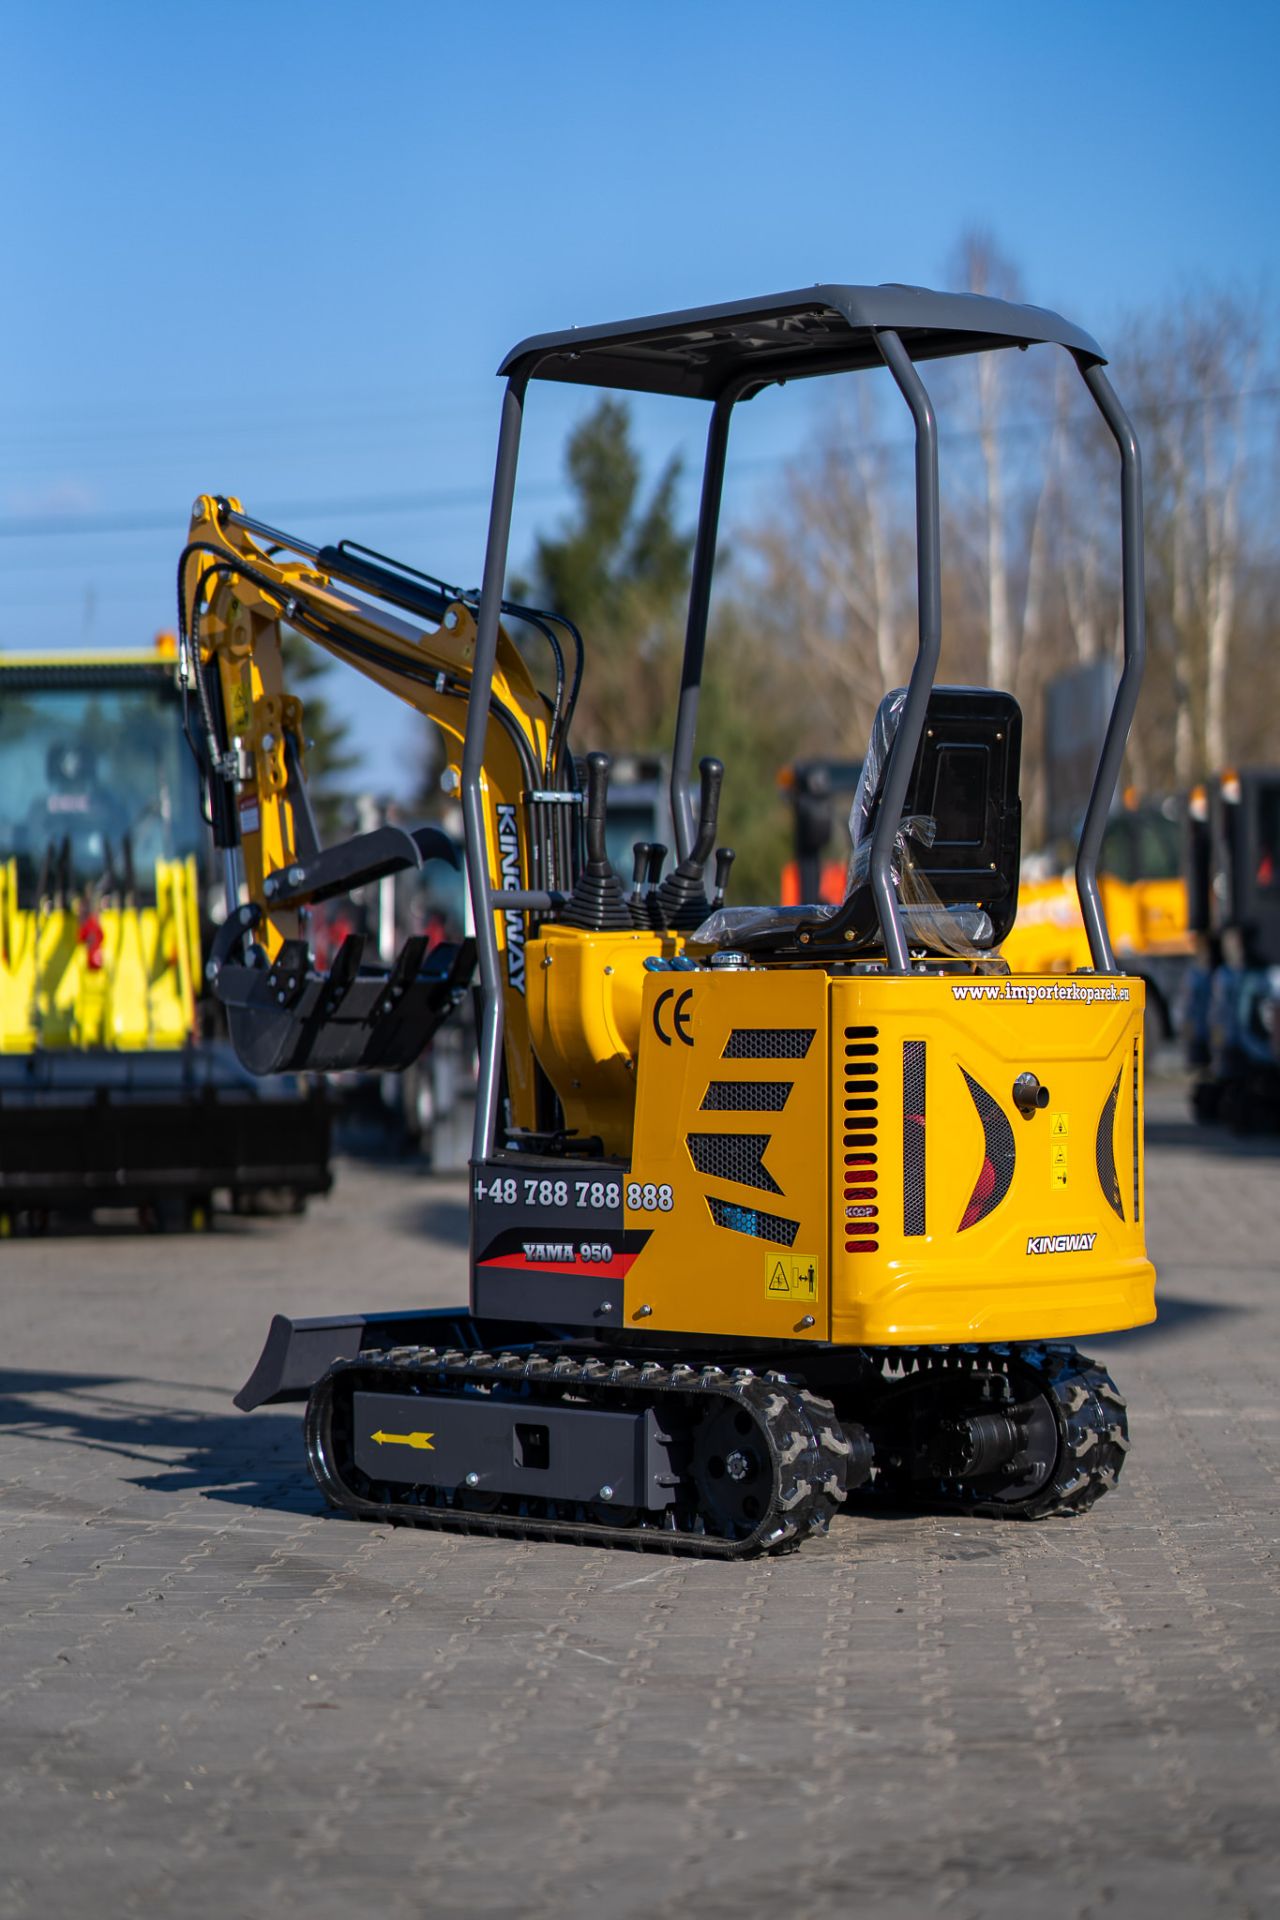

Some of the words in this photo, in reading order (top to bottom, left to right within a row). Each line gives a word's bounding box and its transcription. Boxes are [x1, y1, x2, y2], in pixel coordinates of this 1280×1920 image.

[952, 981, 1130, 1005] www.importerkoparek.eu
[653, 988, 694, 1046] CE
[475, 1178, 517, 1204] +48
[524, 1179, 568, 1206] 788
[575, 1182, 620, 1208] 788
[626, 1184, 674, 1211] 888
[523, 1242, 575, 1263] YAMA
[581, 1243, 612, 1263] 950
[1026, 1233, 1097, 1255] KINGWAY
